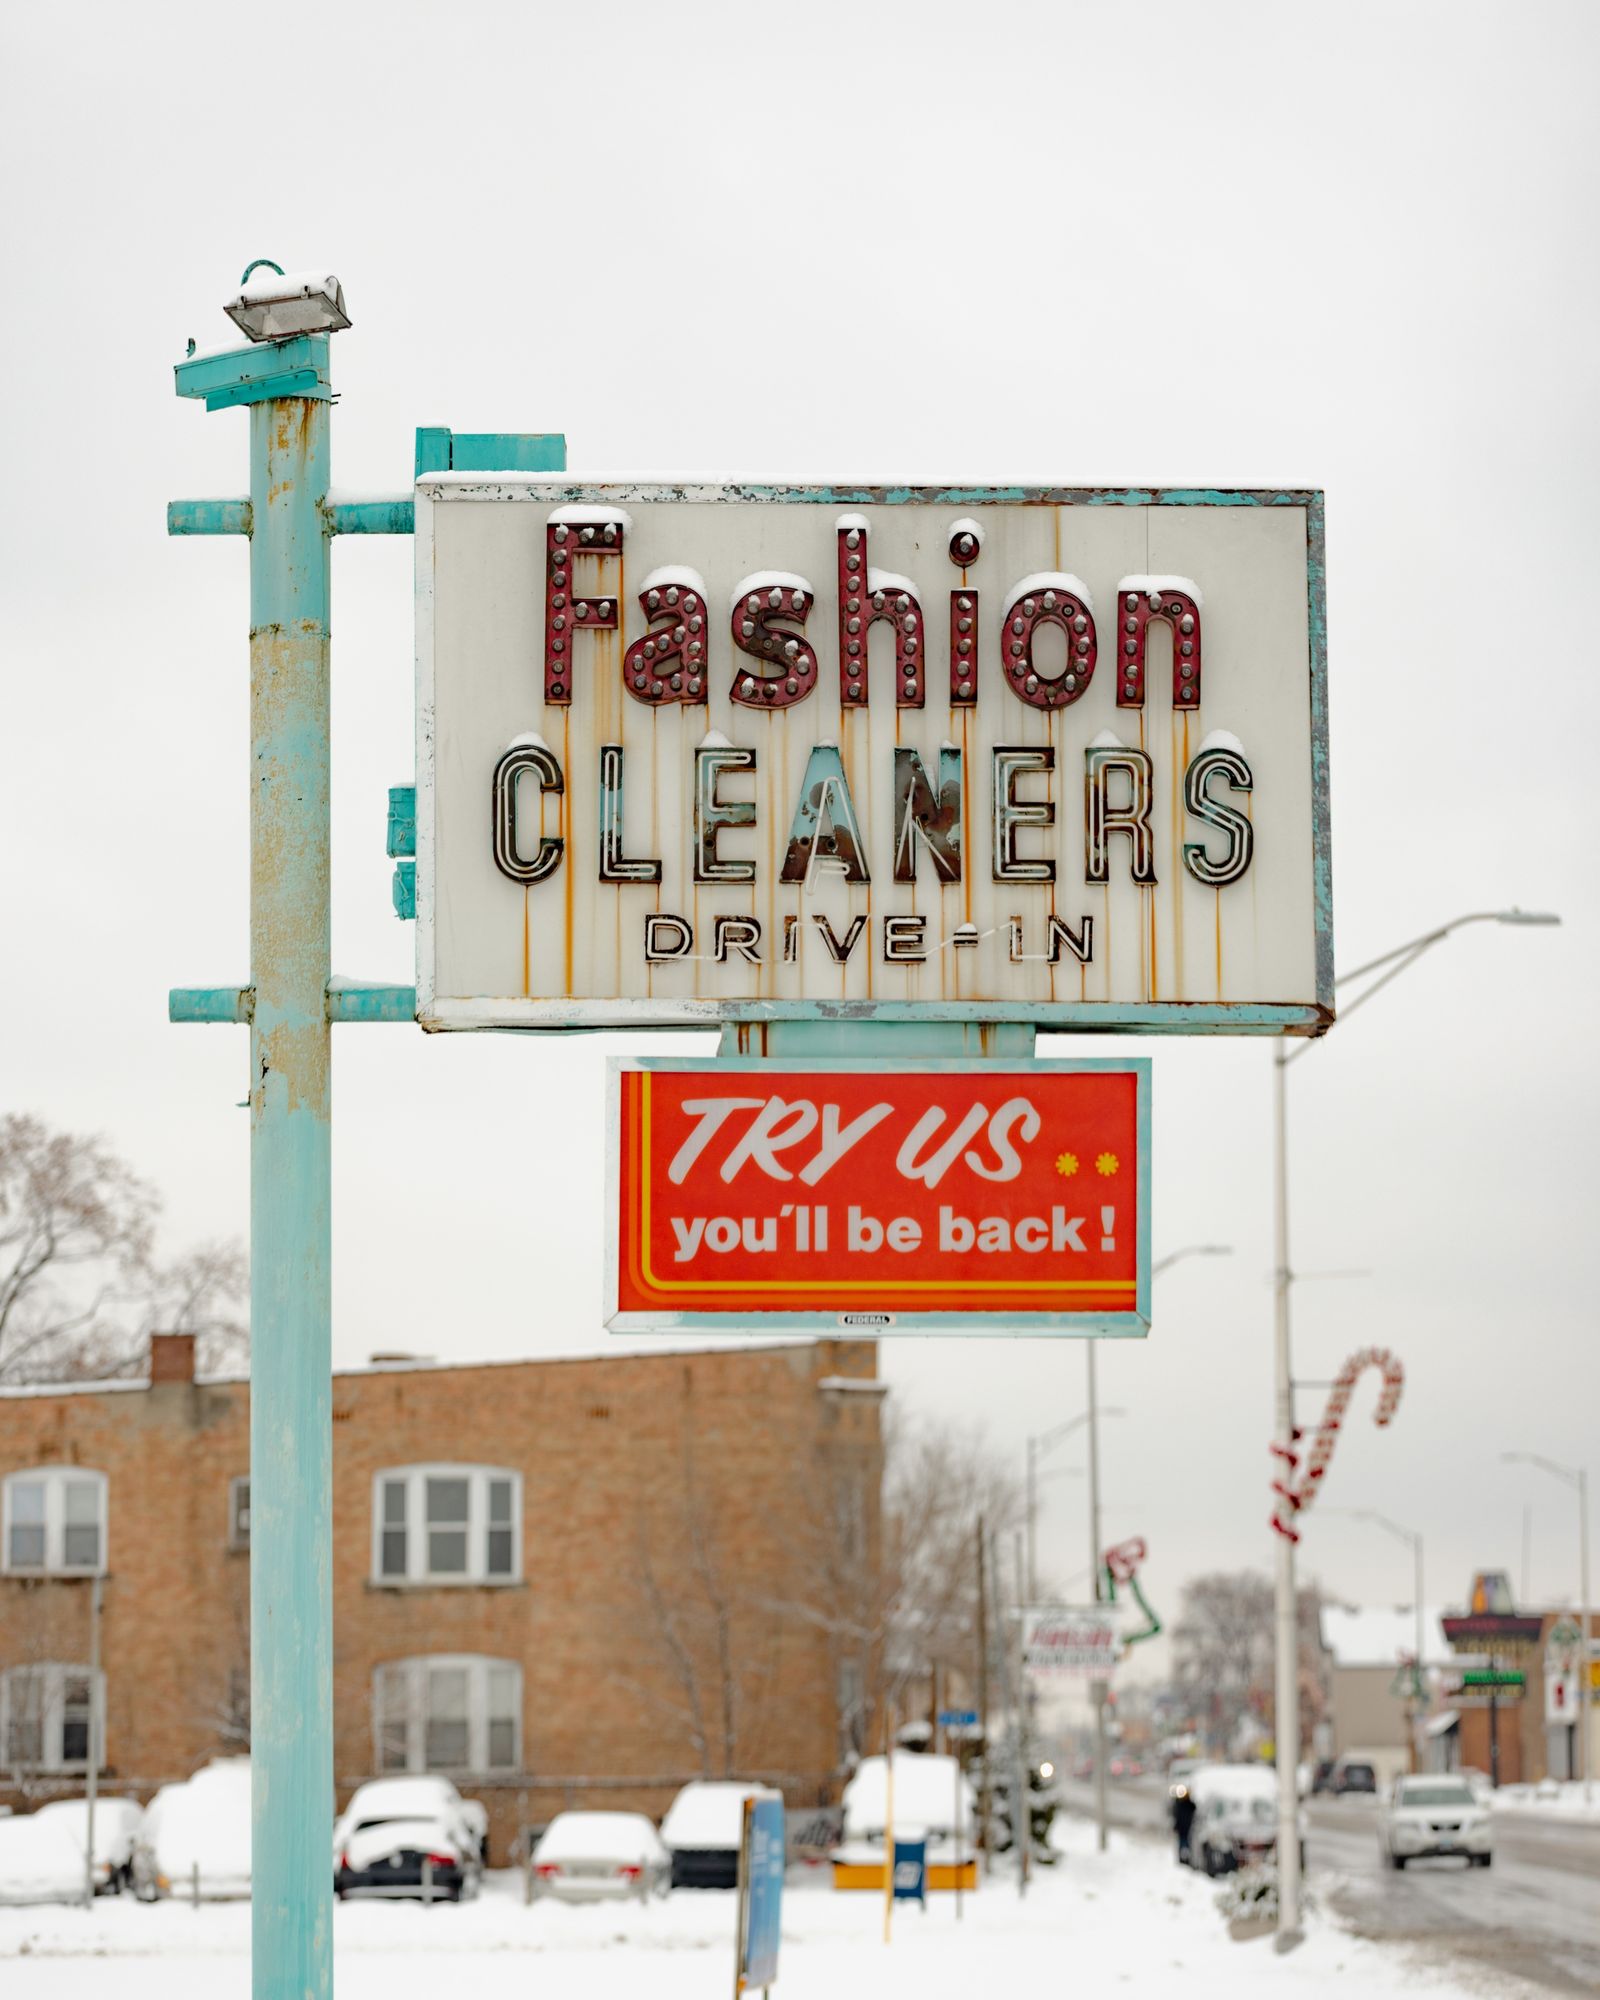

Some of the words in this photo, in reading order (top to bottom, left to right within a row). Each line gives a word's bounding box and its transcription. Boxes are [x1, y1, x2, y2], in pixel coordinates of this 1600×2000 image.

[544, 519, 1202, 709] Fashion
[492, 743, 1255, 886] CLEANERS
[645, 913, 1095, 964] DRIVE-IN
[668, 1096, 895, 1187] TRY
[896, 1097, 1041, 1188] US
[671, 1204, 829, 1262] you'll
[847, 1206, 922, 1252] be
[847, 1315, 888, 1325] FEDERAL
